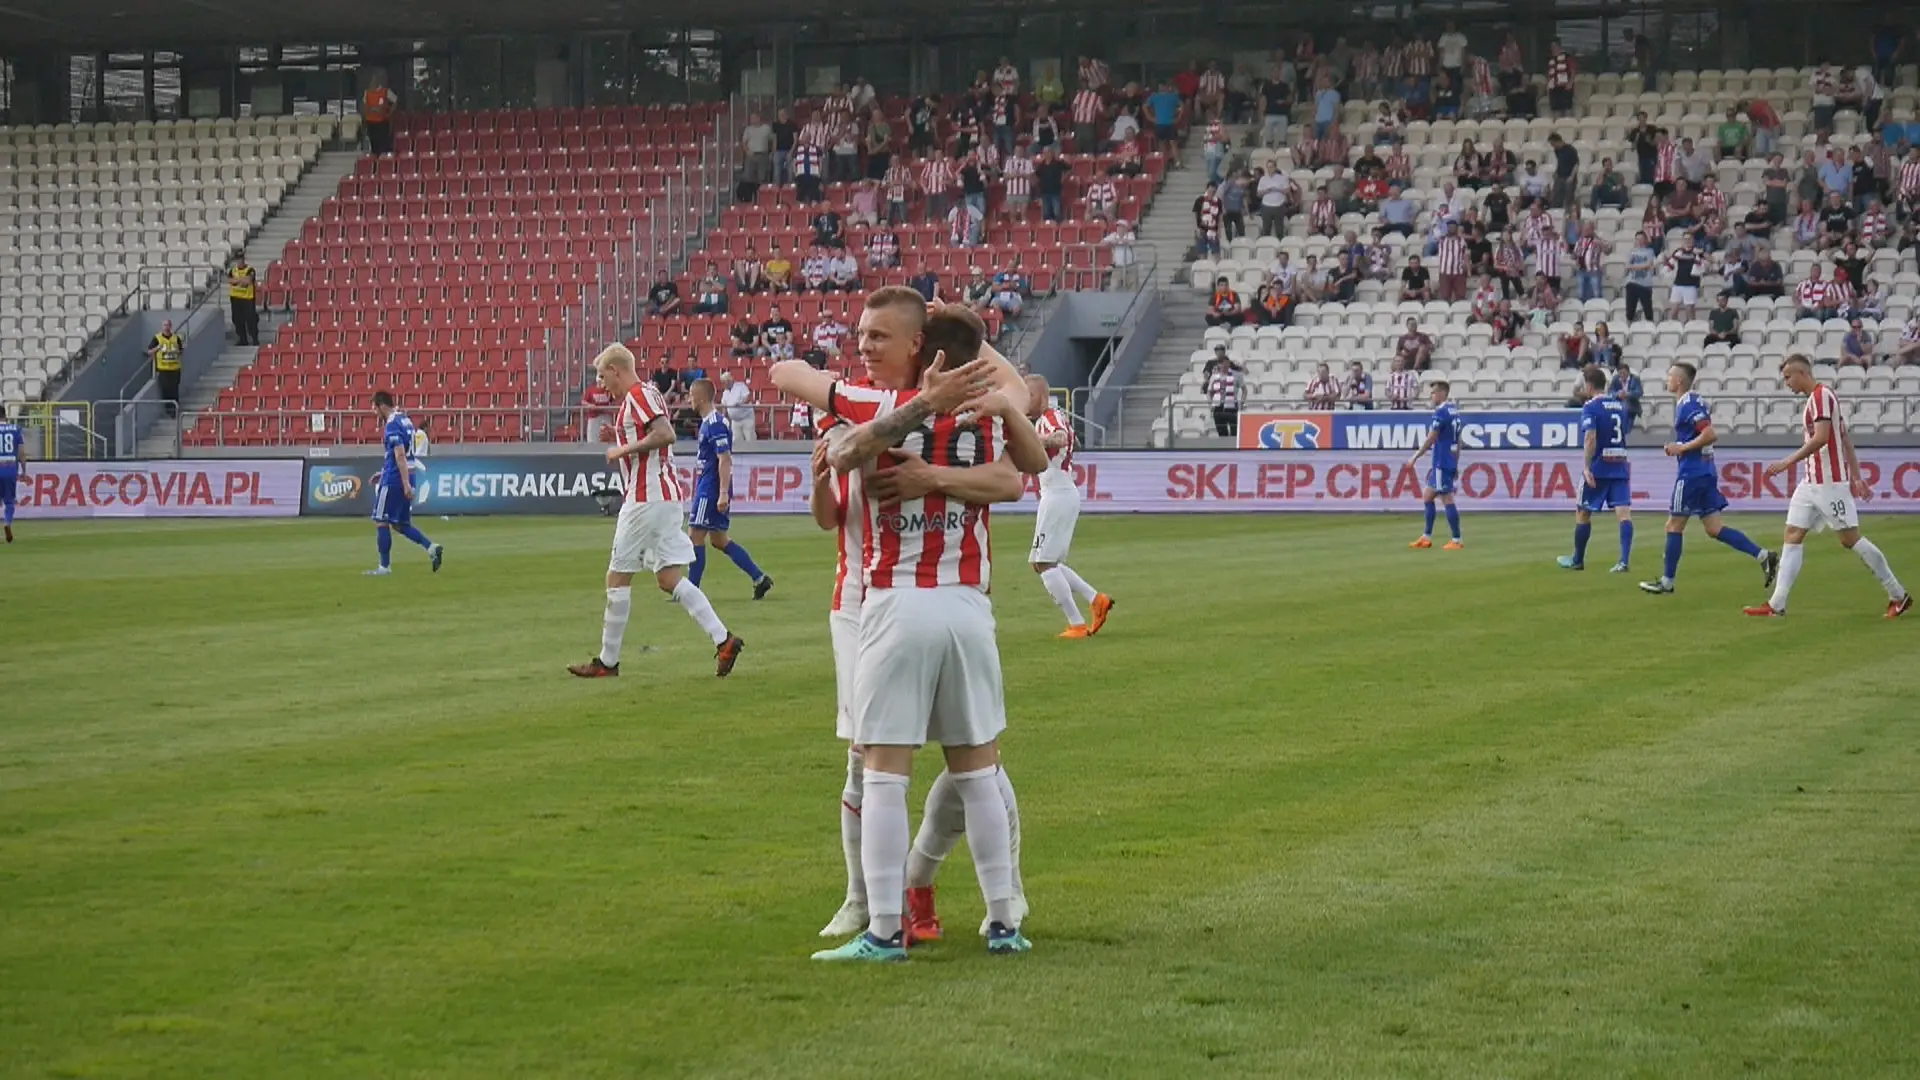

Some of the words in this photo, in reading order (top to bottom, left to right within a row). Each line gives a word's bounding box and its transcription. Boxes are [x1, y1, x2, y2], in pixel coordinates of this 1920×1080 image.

[1258, 420, 1320, 449] STS
[1610, 413, 1622, 443] 3
[324, 479, 353, 498] LOTTO
[437, 472, 625, 497] EKSTRAKLASA
[1830, 499, 1846, 517] 39
